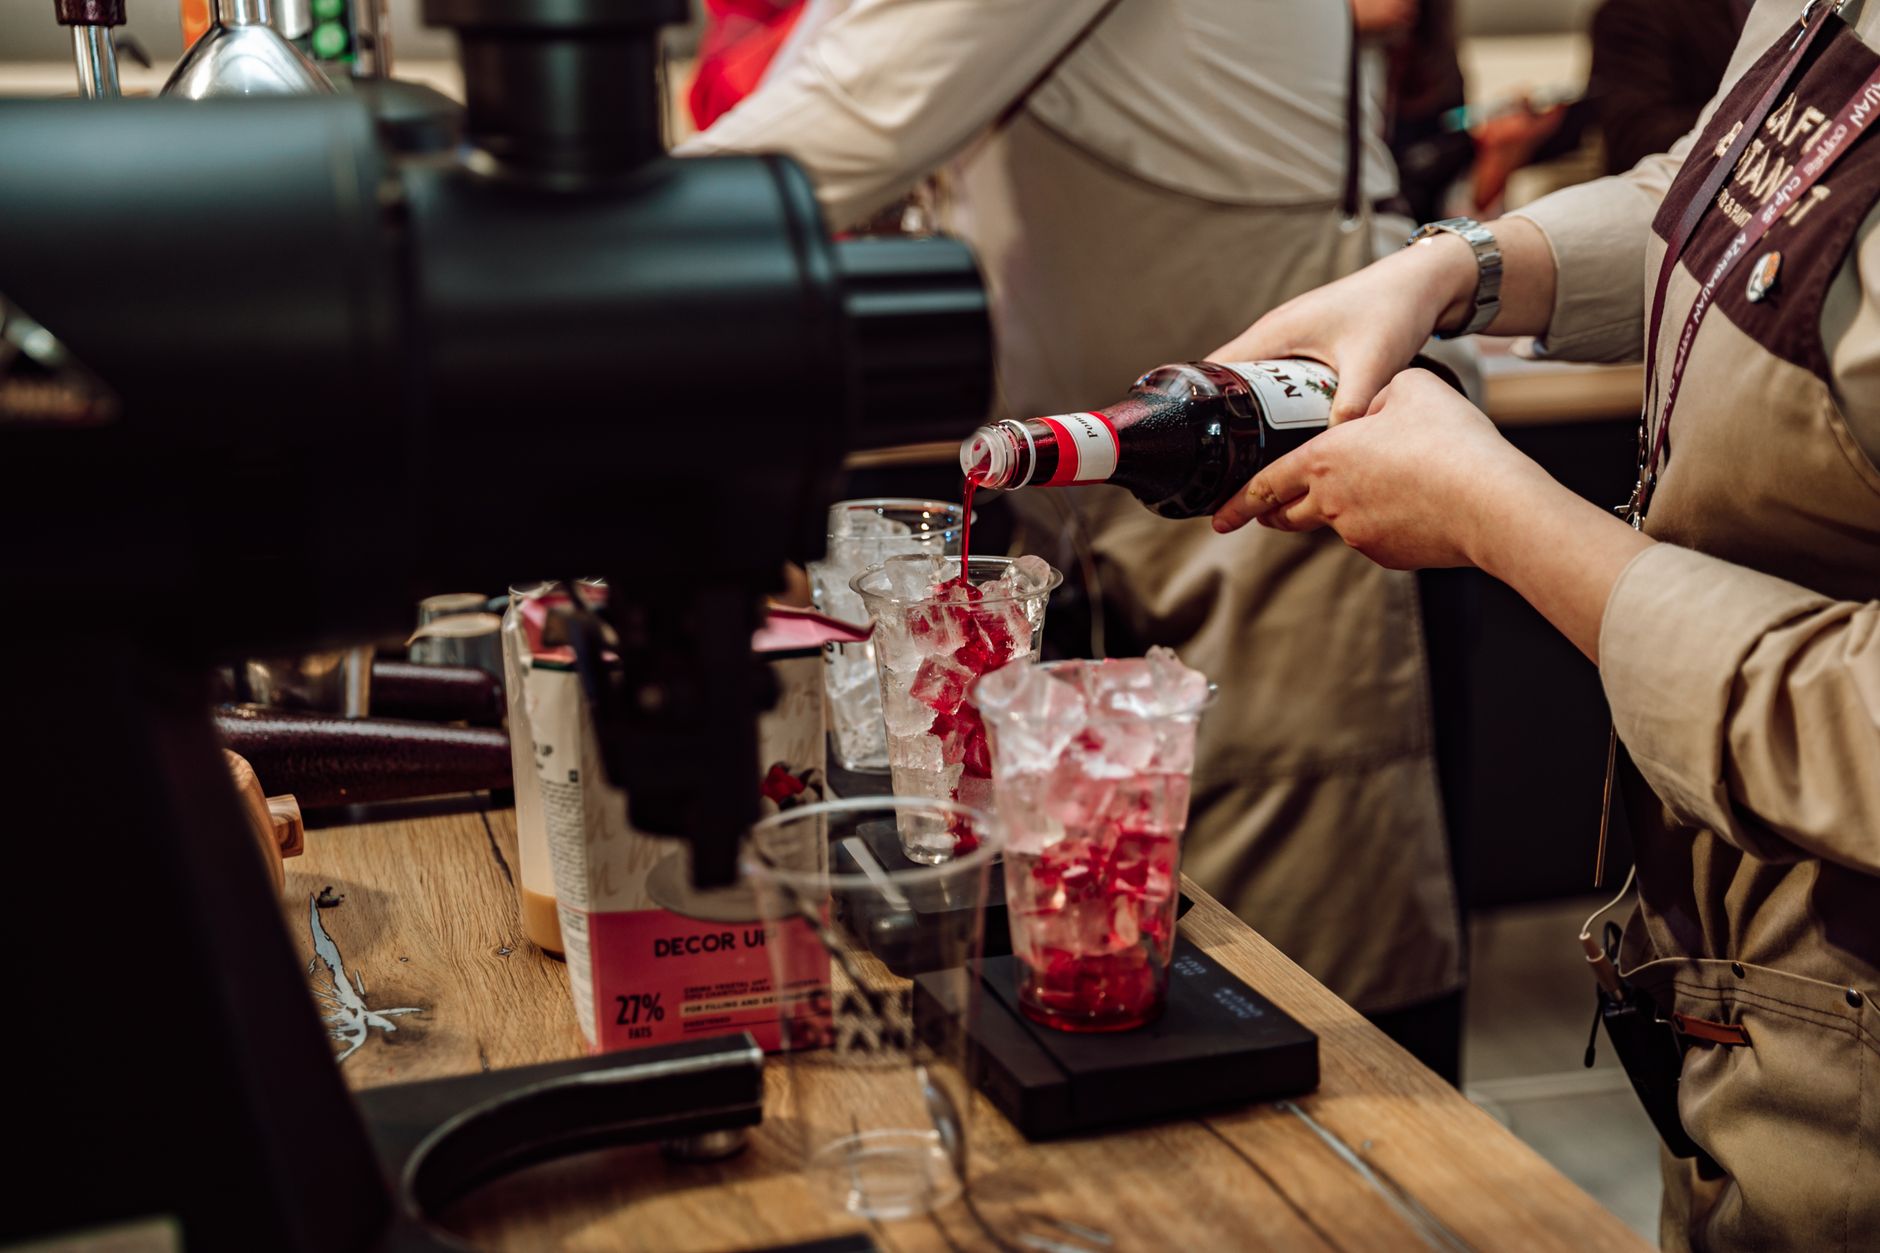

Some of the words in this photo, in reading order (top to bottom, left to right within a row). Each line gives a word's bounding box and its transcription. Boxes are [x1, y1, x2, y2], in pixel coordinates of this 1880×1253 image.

[654, 931, 736, 958] DECOR
[615, 991, 665, 1026] 27%
[705, 1001, 738, 1010] FILLING
[741, 998, 760, 1006] AND
